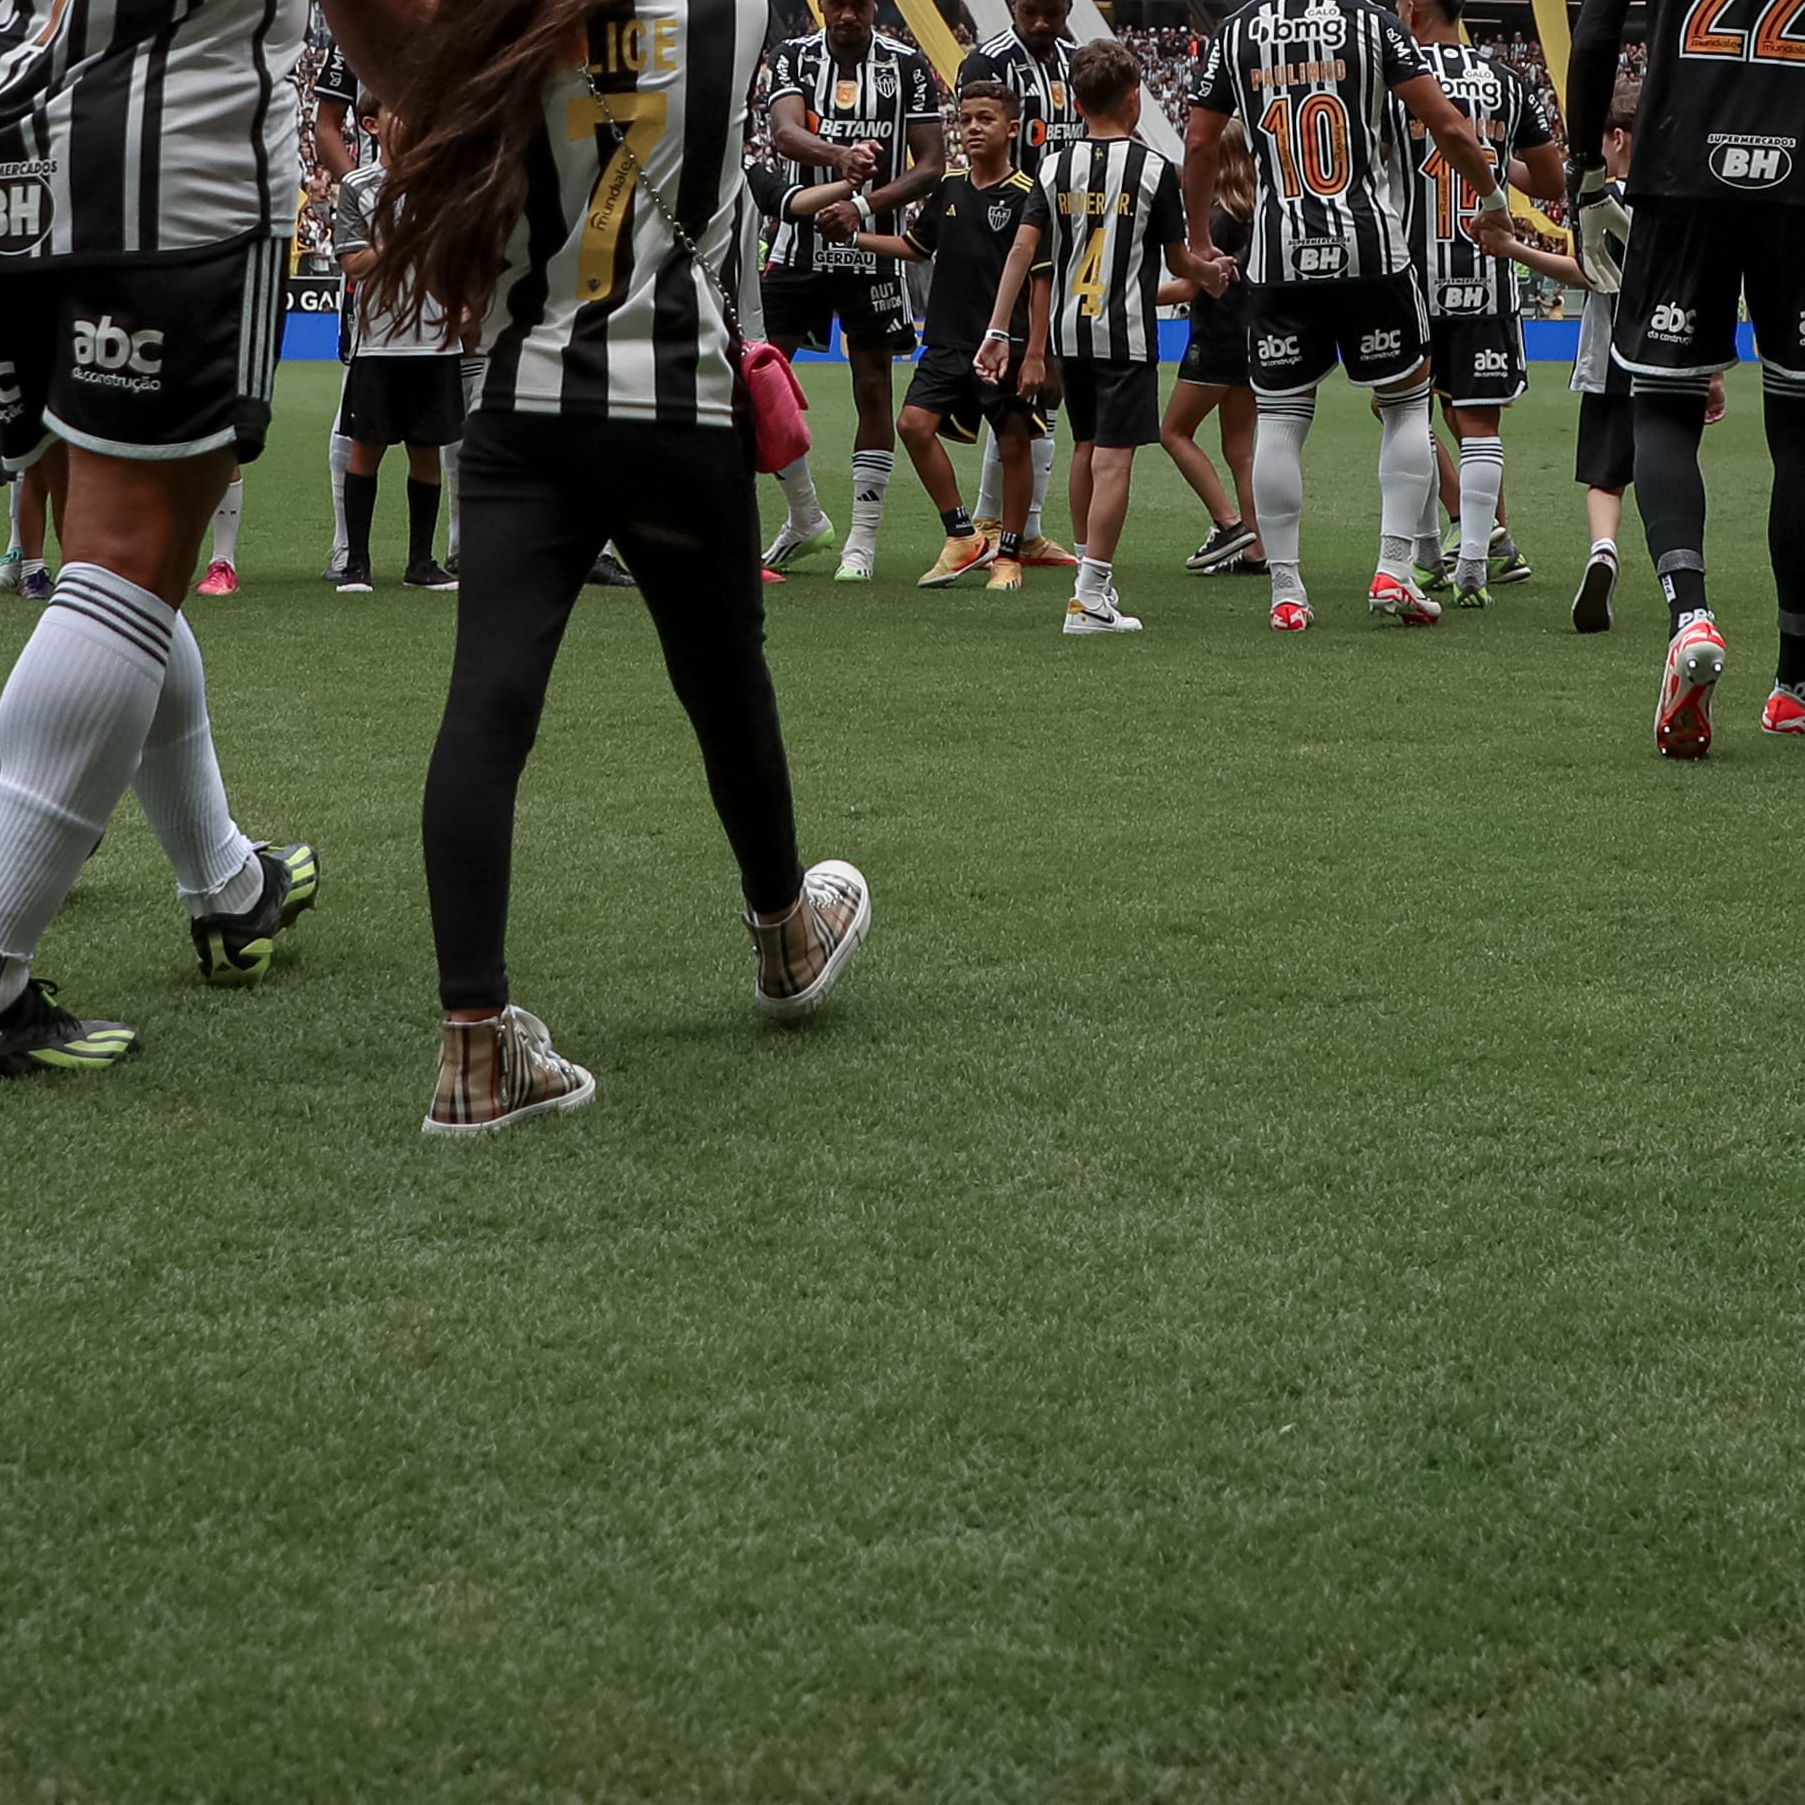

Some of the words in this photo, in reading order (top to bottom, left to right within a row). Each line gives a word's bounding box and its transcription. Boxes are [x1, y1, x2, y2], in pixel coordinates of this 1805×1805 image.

[1308, 8, 1337, 17] GALO
[1274, 17, 1344, 46] bmg
[1250, 60, 1346, 92] PAULINHO
[820, 120, 893, 139] BETANO
[1708, 134, 1796, 147] SUPERMERCADOS
[1257, 90, 1354, 199] 10
[1722, 148, 1780, 179] BH
[567, 91, 668, 301] 7
[591, 160, 634, 232] mundiale
[815, 252, 874, 266] GERDAU
[1300, 247, 1341, 271] BH
[1072, 228, 1108, 317] 4
[871, 283, 896, 300] AUT
[1445, 287, 1483, 307] BH
[73, 315, 164, 374] abc
[1258, 334, 1299, 359] abc
[1360, 329, 1401, 354] abc
[1647, 330, 1658, 339] da
[1474, 349, 1508, 371] abc
[86, 369, 160, 393] construção
